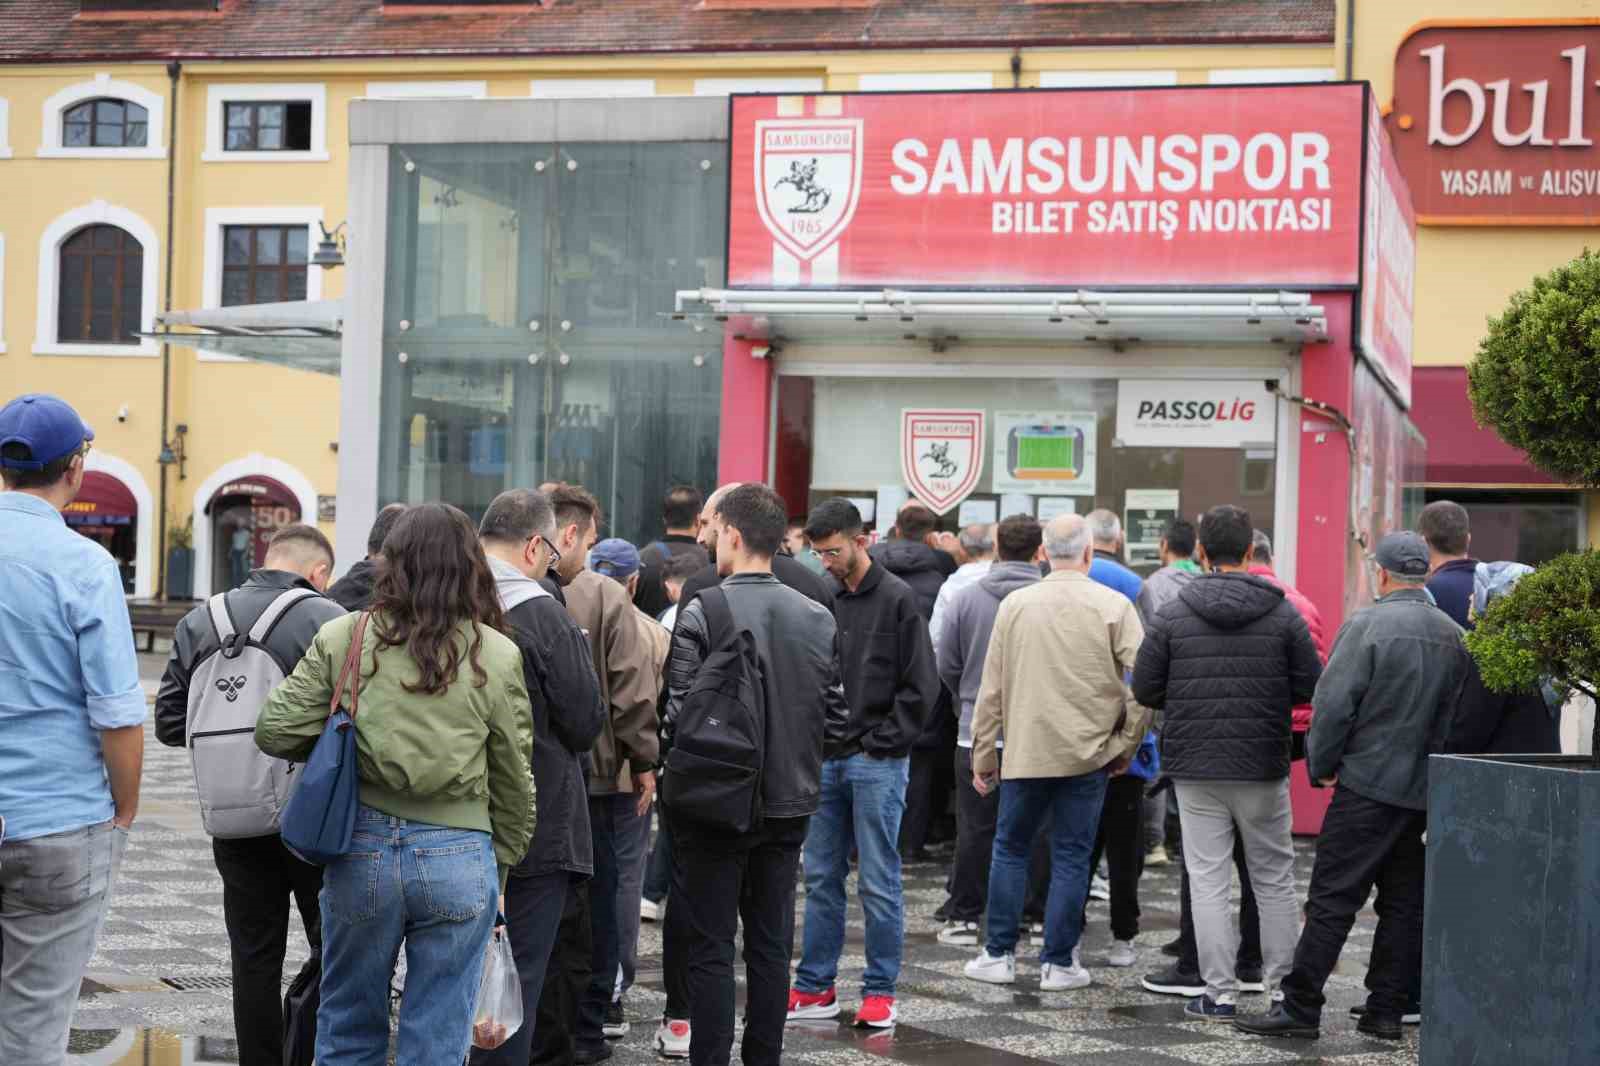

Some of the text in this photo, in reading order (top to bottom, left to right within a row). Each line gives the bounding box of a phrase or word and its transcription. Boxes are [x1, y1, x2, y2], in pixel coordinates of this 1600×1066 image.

[1420, 43, 1600, 147] bul
[766, 133, 850, 147] SAMSUNSPOR
[890, 131, 1331, 196] SAMSUNSPOR
[791, 219, 822, 234] 1965
[1087, 199, 1180, 240] SATIŞ
[1188, 197, 1333, 232] NOKTASI
